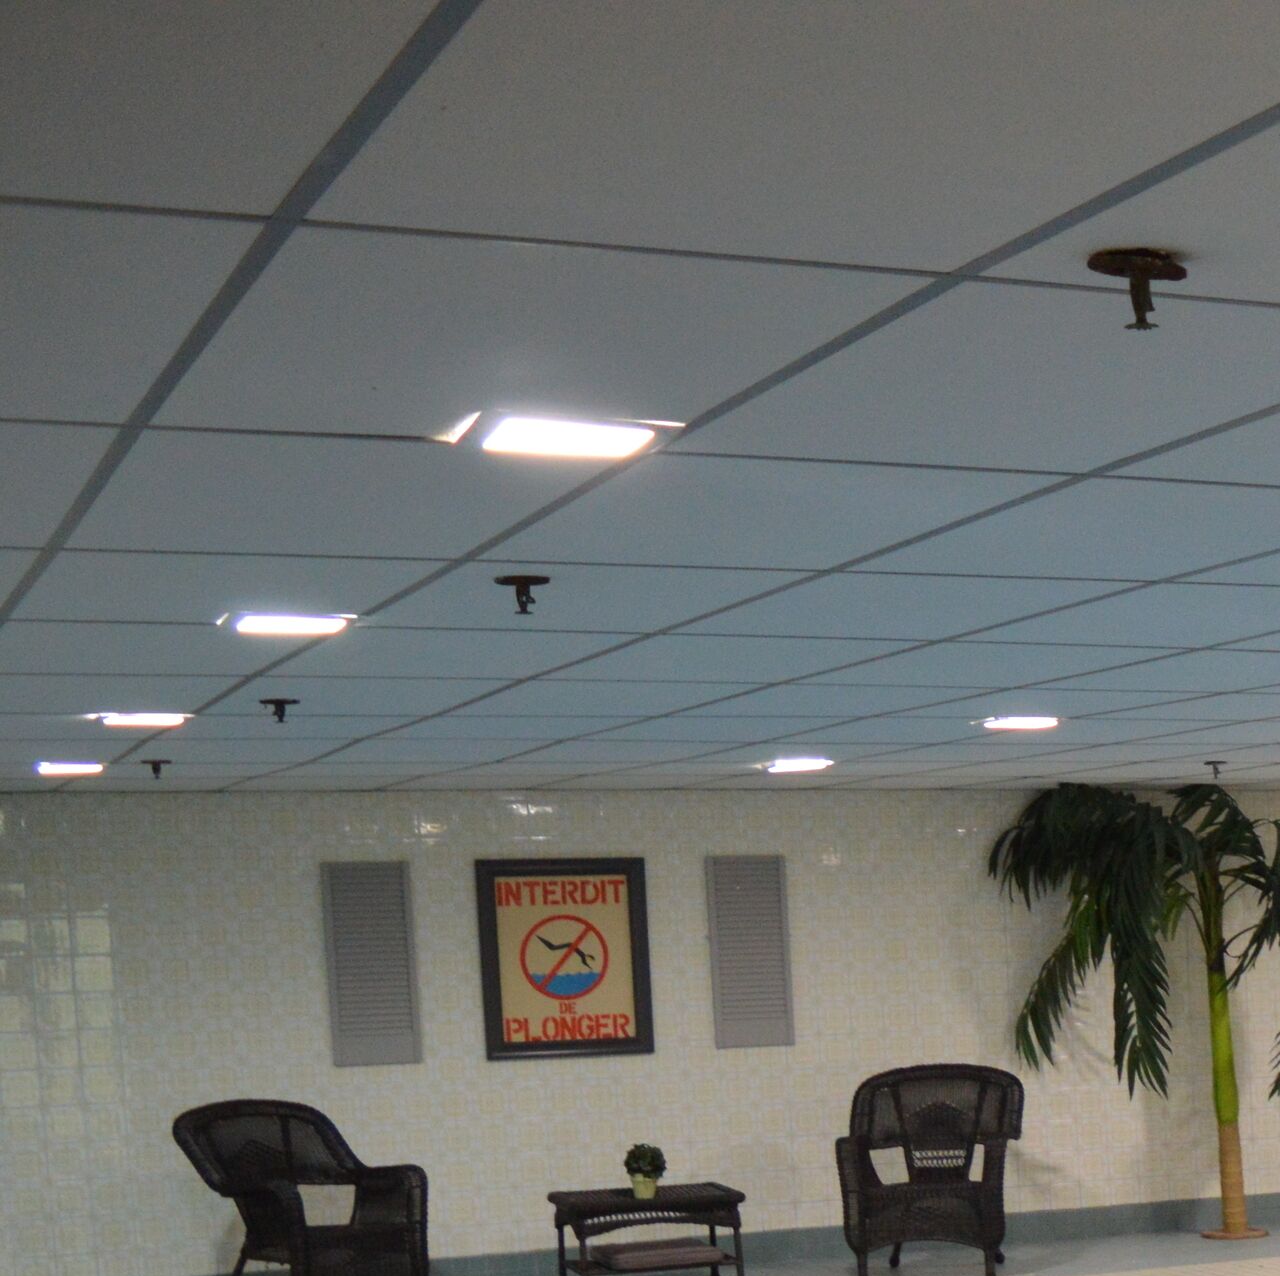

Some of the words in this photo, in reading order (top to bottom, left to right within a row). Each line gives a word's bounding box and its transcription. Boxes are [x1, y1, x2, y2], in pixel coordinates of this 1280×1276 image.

[495, 880, 625, 907] INTERDIT
[559, 1002, 577, 1015] DE
[504, 1013, 630, 1041] PLONGER
